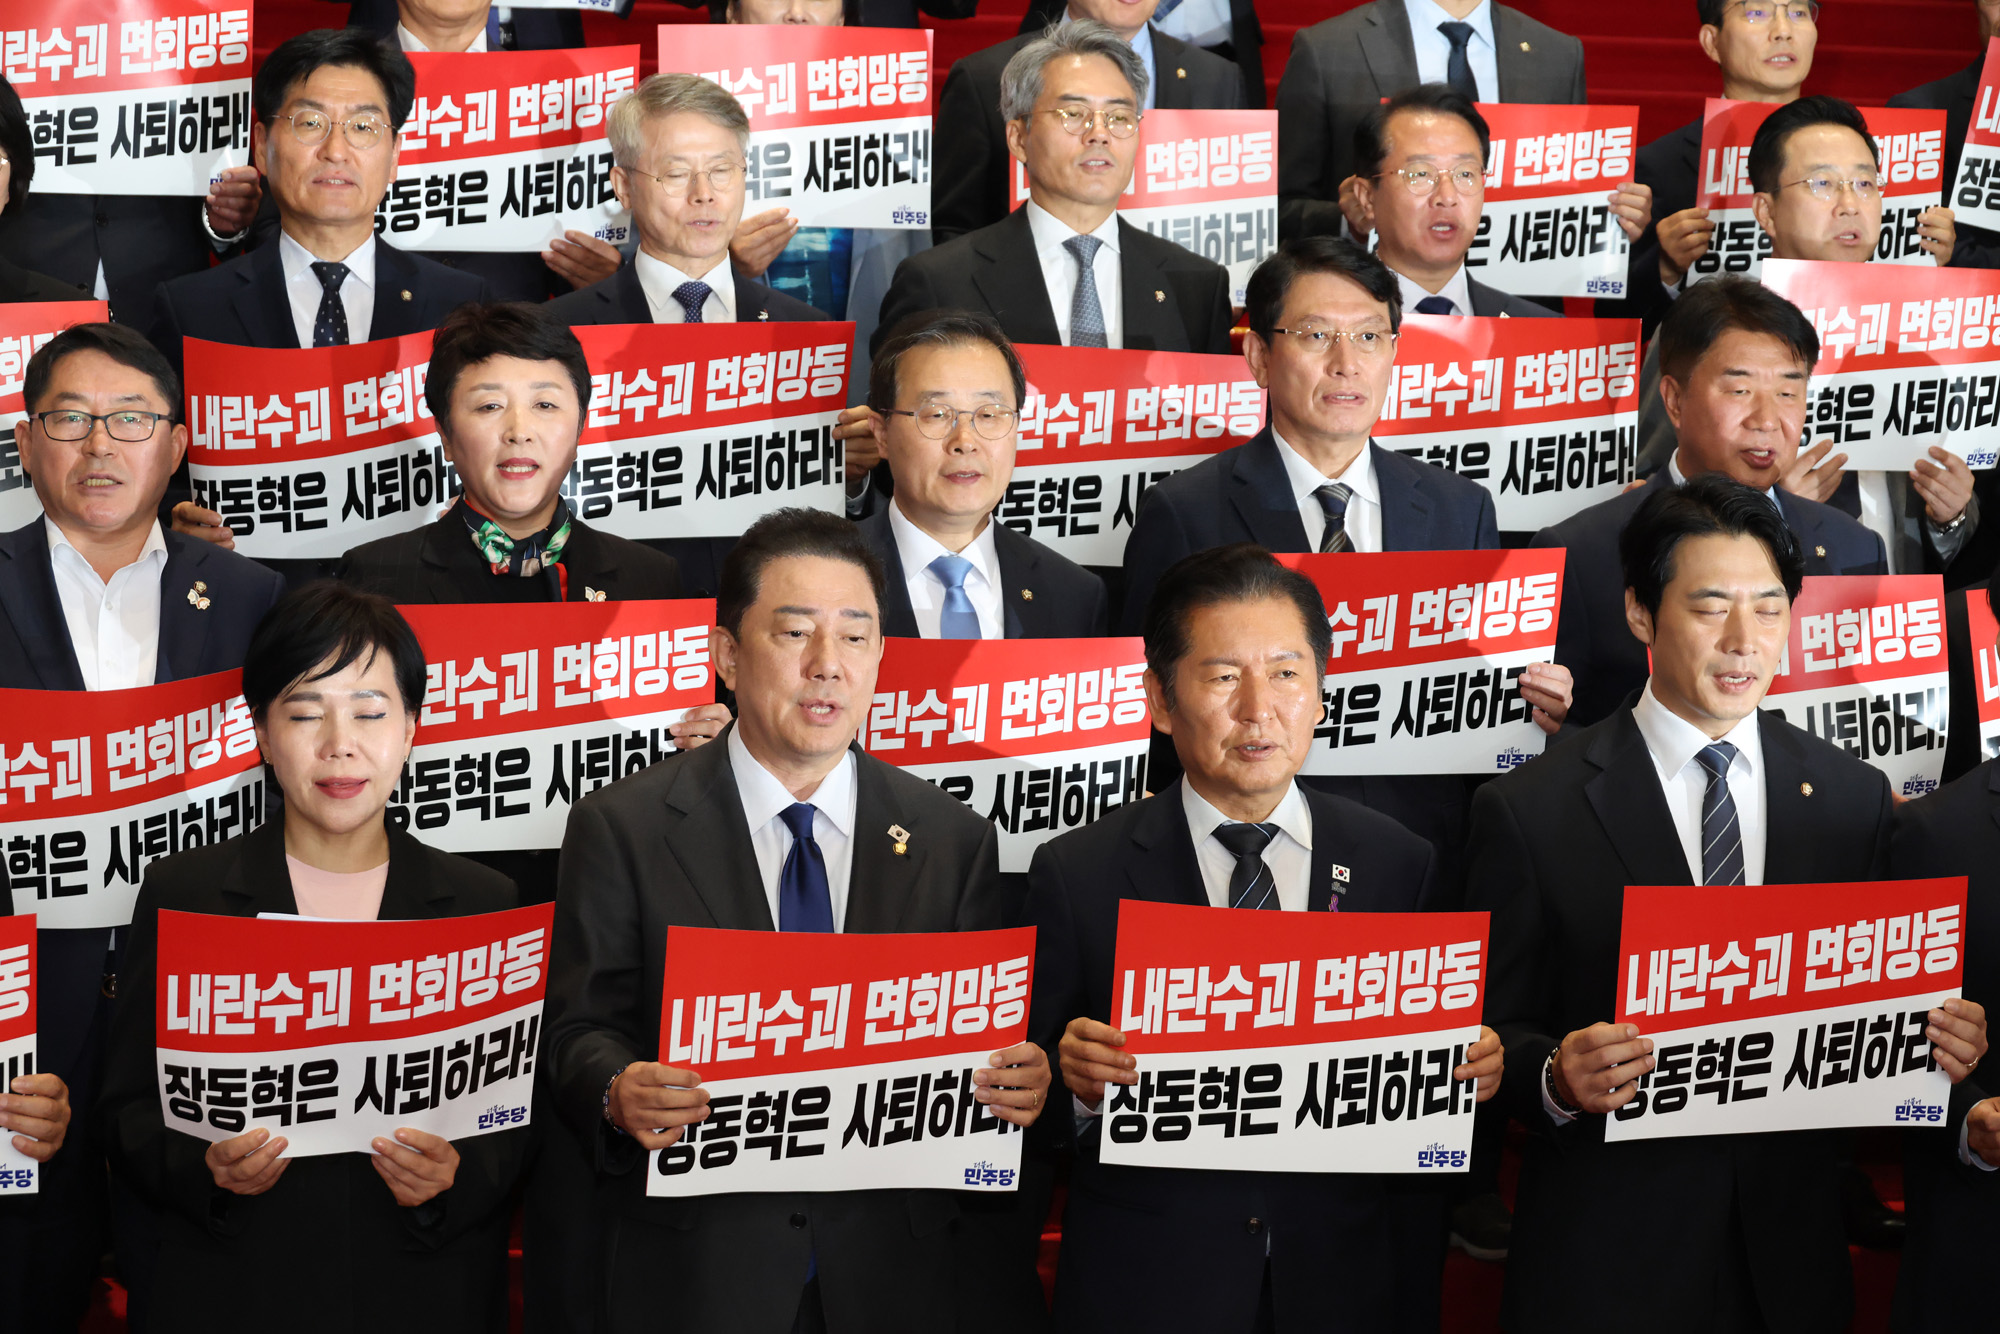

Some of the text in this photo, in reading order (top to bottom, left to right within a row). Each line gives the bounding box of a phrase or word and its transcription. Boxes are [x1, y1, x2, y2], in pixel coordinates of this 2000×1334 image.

[0, 9, 249, 84] 란수괴 면회망동
[400, 89, 497, 151] 란수괴
[688, 50, 928, 118] 수괴 면회망동
[24, 91, 250, 167] 혁은 사퇴하라!
[803, 129, 929, 193] 사퇴하라!
[1145, 131, 1273, 194] 면회망동
[1513, 126, 1632, 187] 면회망동
[1872, 130, 1942, 184] 망동
[500, 152, 621, 219] 사퇴하라
[892, 210, 928, 225] 민주당
[595, 227, 627, 242] 민주당
[1586, 280, 1624, 295] 민주당
[1807, 303, 1891, 360] 수괴
[191, 361, 435, 450] 내란수괴 면회
[588, 343, 848, 429] 란수괴 면회망동
[1513, 341, 1636, 410] 면회망동
[1800, 375, 2000, 447] 혁은 사퇴하라
[1016, 380, 1262, 451] 란수괴 면회망동
[341, 445, 463, 524] 사퇴하
[695, 424, 843, 501] 사퇴하라!
[1500, 424, 1636, 496] 사퇴하라!
[1966, 453, 1998, 466] 민주당
[994, 474, 1103, 538] 동혁은
[1328, 572, 1557, 658] 수괴 면회망동
[1800, 598, 1942, 674] 면회망동
[420, 625, 710, 727] 란수괴 면회망동
[855, 662, 1148, 751] 란수괴 면회망동
[1312, 660, 1552, 749] 혁은 사퇴하라
[0, 694, 259, 805] 수괴 면회망동
[545, 728, 687, 809] 사퇴하
[987, 753, 1146, 834] 사퇴하라!
[1902, 779, 1938, 796] 민주당
[0, 830, 89, 901] 혁은
[166, 928, 545, 1035] 내란수괴 면회망동
[1120, 940, 1482, 1035] 내란수괴 면회망동
[1625, 904, 1960, 1017] 내란수괴 면회망동
[668, 955, 1029, 1064] 내란수괴 면회망동
[164, 1014, 540, 1133] 장동혁은 사퇴하라!
[1782, 1006, 1946, 1092] 사퇴하라
[477, 1105, 528, 1130] 민주당
[841, 1063, 1022, 1151] 사퇴하
[1109, 1042, 1475, 1144] 장동혁은 사퇴하라!
[1894, 1104, 1944, 1122] 민주당
[0, 1169, 34, 1189] 주당
[964, 1168, 1016, 1186] 민주당
[1417, 1150, 1468, 1168] 민주당
